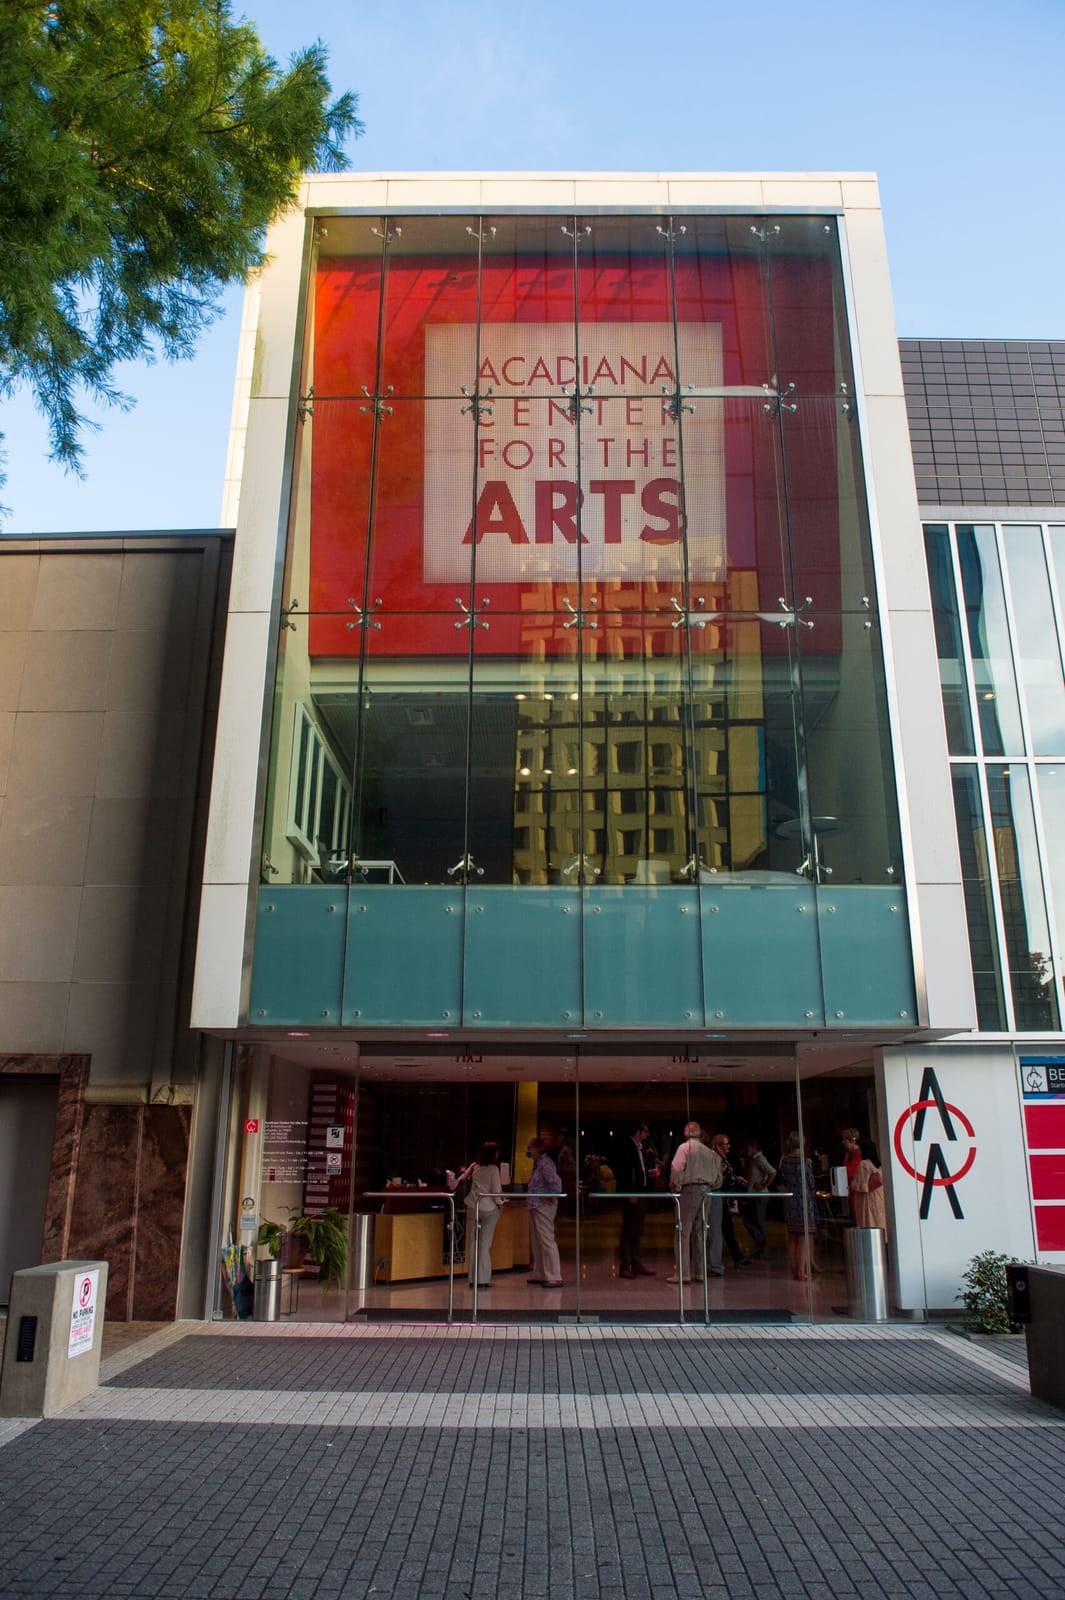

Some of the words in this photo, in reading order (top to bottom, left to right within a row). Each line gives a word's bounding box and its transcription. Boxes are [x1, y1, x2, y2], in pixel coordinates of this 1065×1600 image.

[476, 355, 676, 386] ACADIANA
[479, 438, 567, 469] FOR
[597, 438, 676, 468] THE
[462, 478, 688, 545] ARTS
